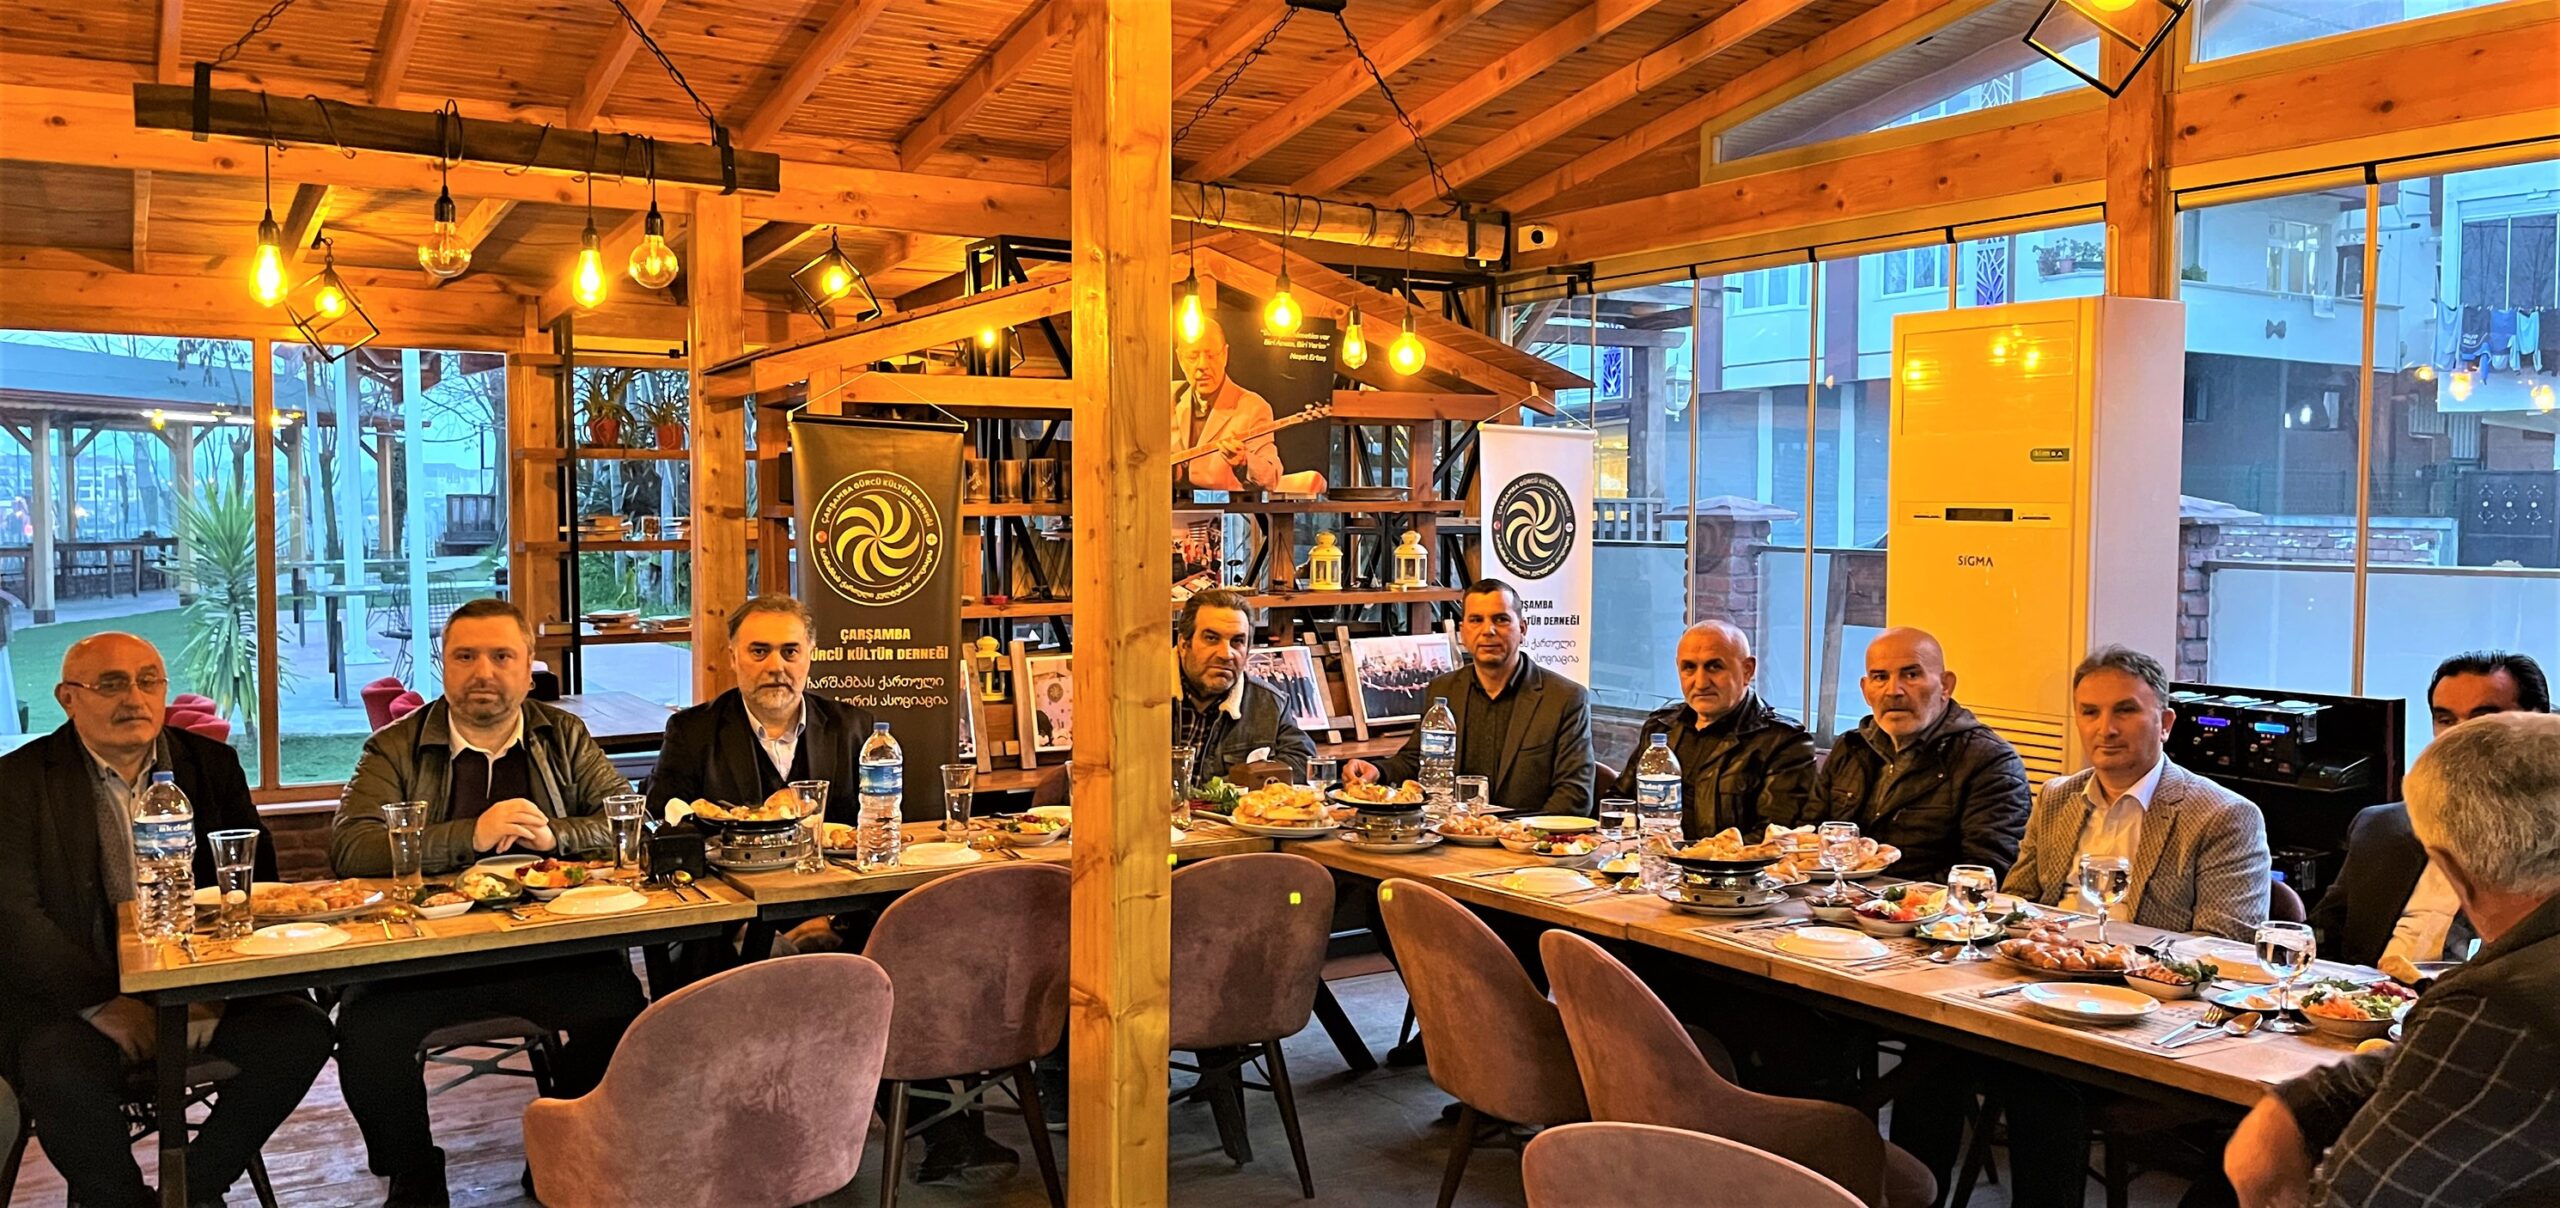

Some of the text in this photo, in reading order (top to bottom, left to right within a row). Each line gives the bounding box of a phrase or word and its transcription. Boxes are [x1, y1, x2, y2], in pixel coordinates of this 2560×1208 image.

[821, 486, 855, 524] ÇARŞAMBA
[853, 477, 882, 490] GÜRCÜ
[883, 478, 913, 498] KÜLTÜR
[840, 628, 912, 644] ÇARŞAMBA
[810, 645, 949, 661] ÜRCÜ KÜLTÜR DERNEĞİ
[878, 674, 945, 690] ქართული
[880, 693, 949, 709] ასოციაცია
